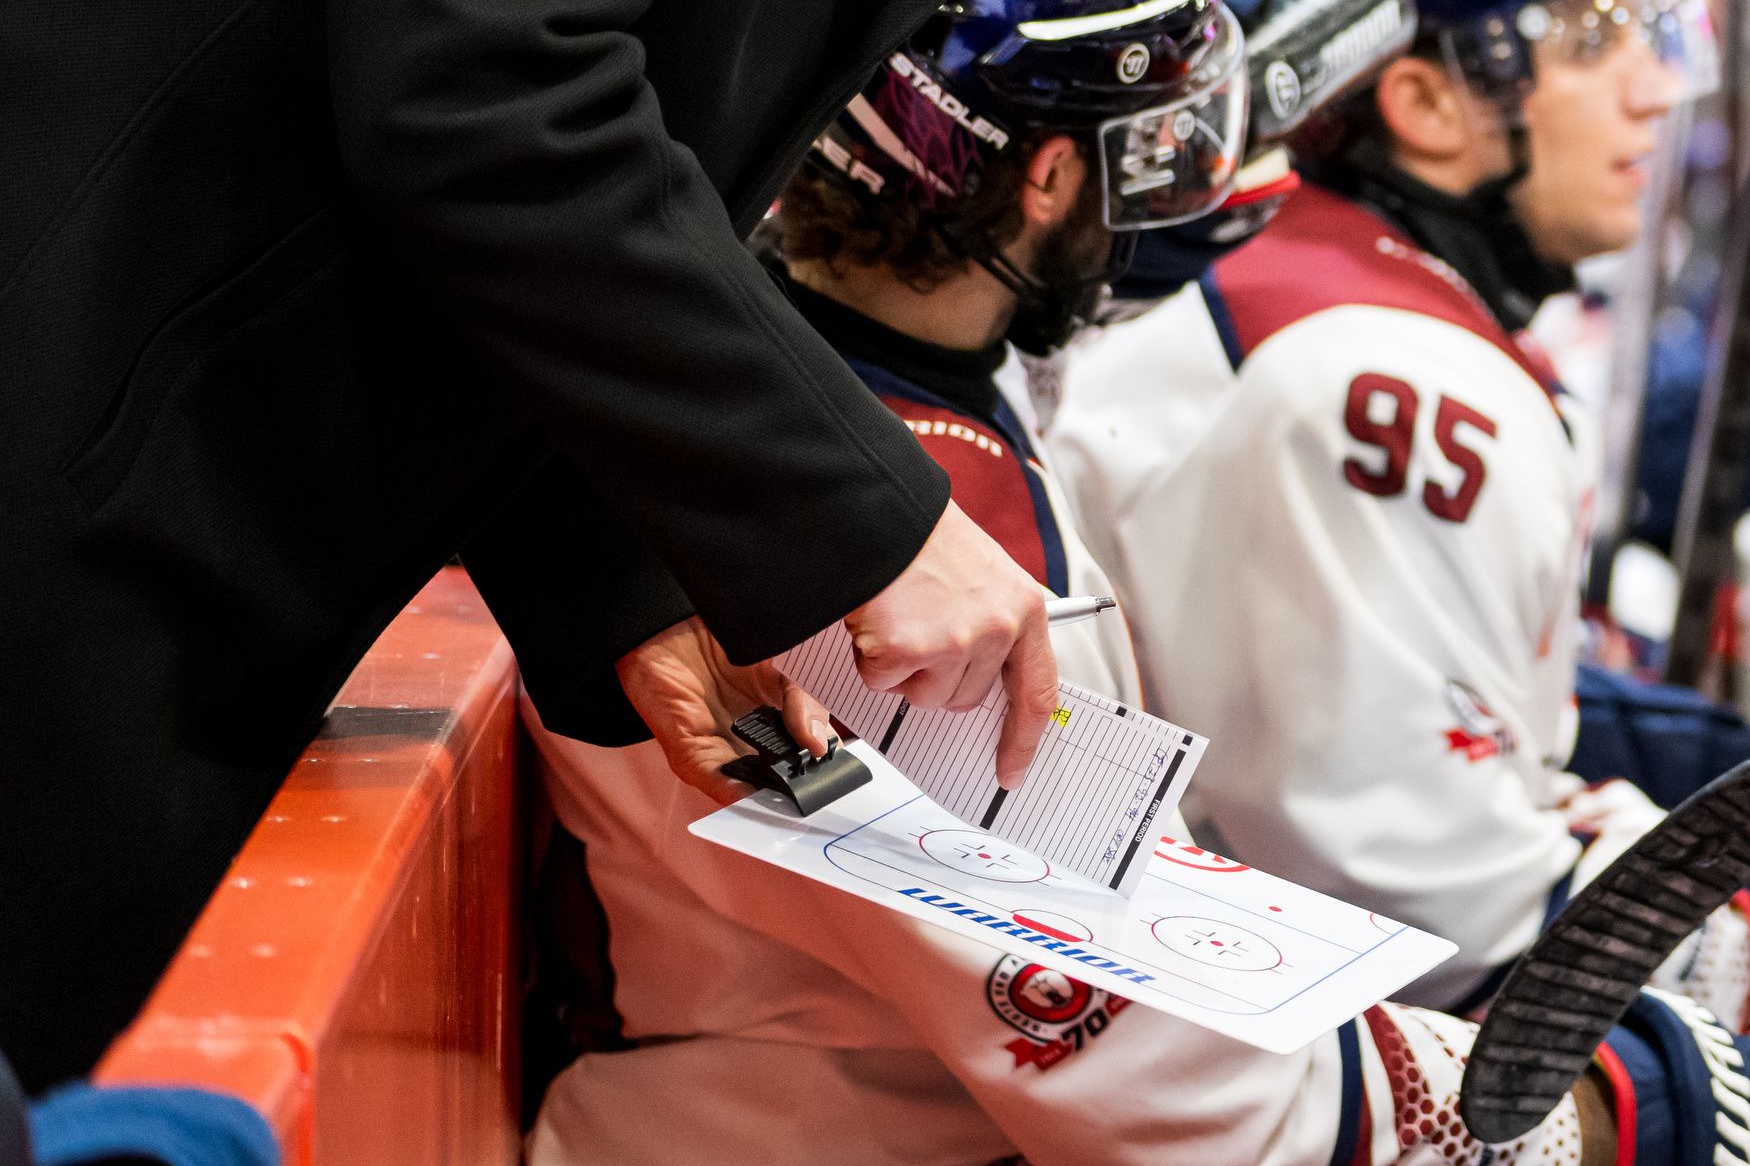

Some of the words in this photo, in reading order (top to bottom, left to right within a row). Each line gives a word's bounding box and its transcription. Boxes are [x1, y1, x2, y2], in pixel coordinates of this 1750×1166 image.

[889, 52, 1010, 150] STADLER
[1344, 372, 1497, 523] 95
[1135, 818, 1153, 843] PERIOD
[1147, 799, 1161, 820] FIRST
[898, 887, 1156, 984] WARRIOR
[1061, 1008, 1109, 1052] 70
